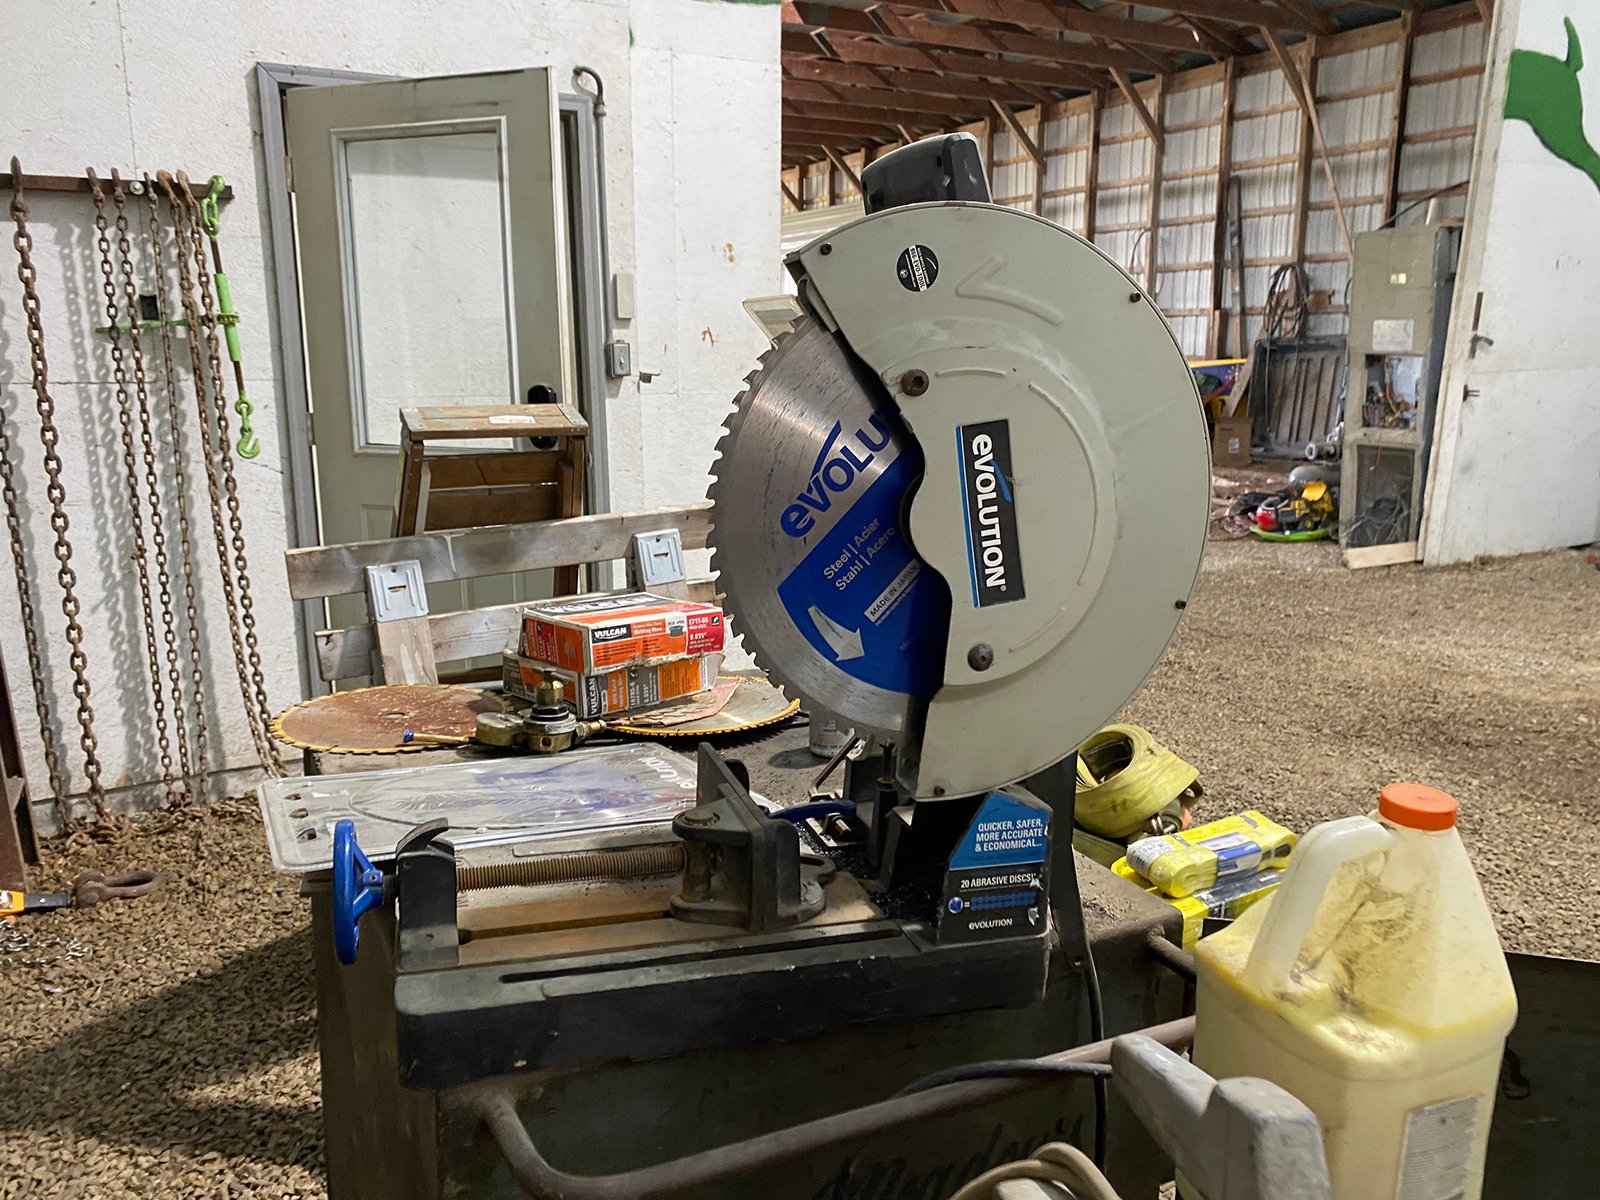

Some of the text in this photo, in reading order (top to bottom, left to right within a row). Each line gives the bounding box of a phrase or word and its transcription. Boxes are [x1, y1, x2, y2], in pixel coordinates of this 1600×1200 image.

[780, 413, 893, 539] eVOLU
[823, 518, 880, 580] Steel Acier
[835, 528, 897, 592] Stahl Acero
[869, 595, 892, 618] MADE
[888, 587, 899, 599] IN
[593, 627, 627, 638] VULCAN
[589, 678, 598, 715] VULCAN
[974, 843, 982, 853] &
[976, 828, 1043, 842] MORE ACCURATE
[960, 879, 970, 889] 20
[970, 875, 1008, 888] ABRASIVE
